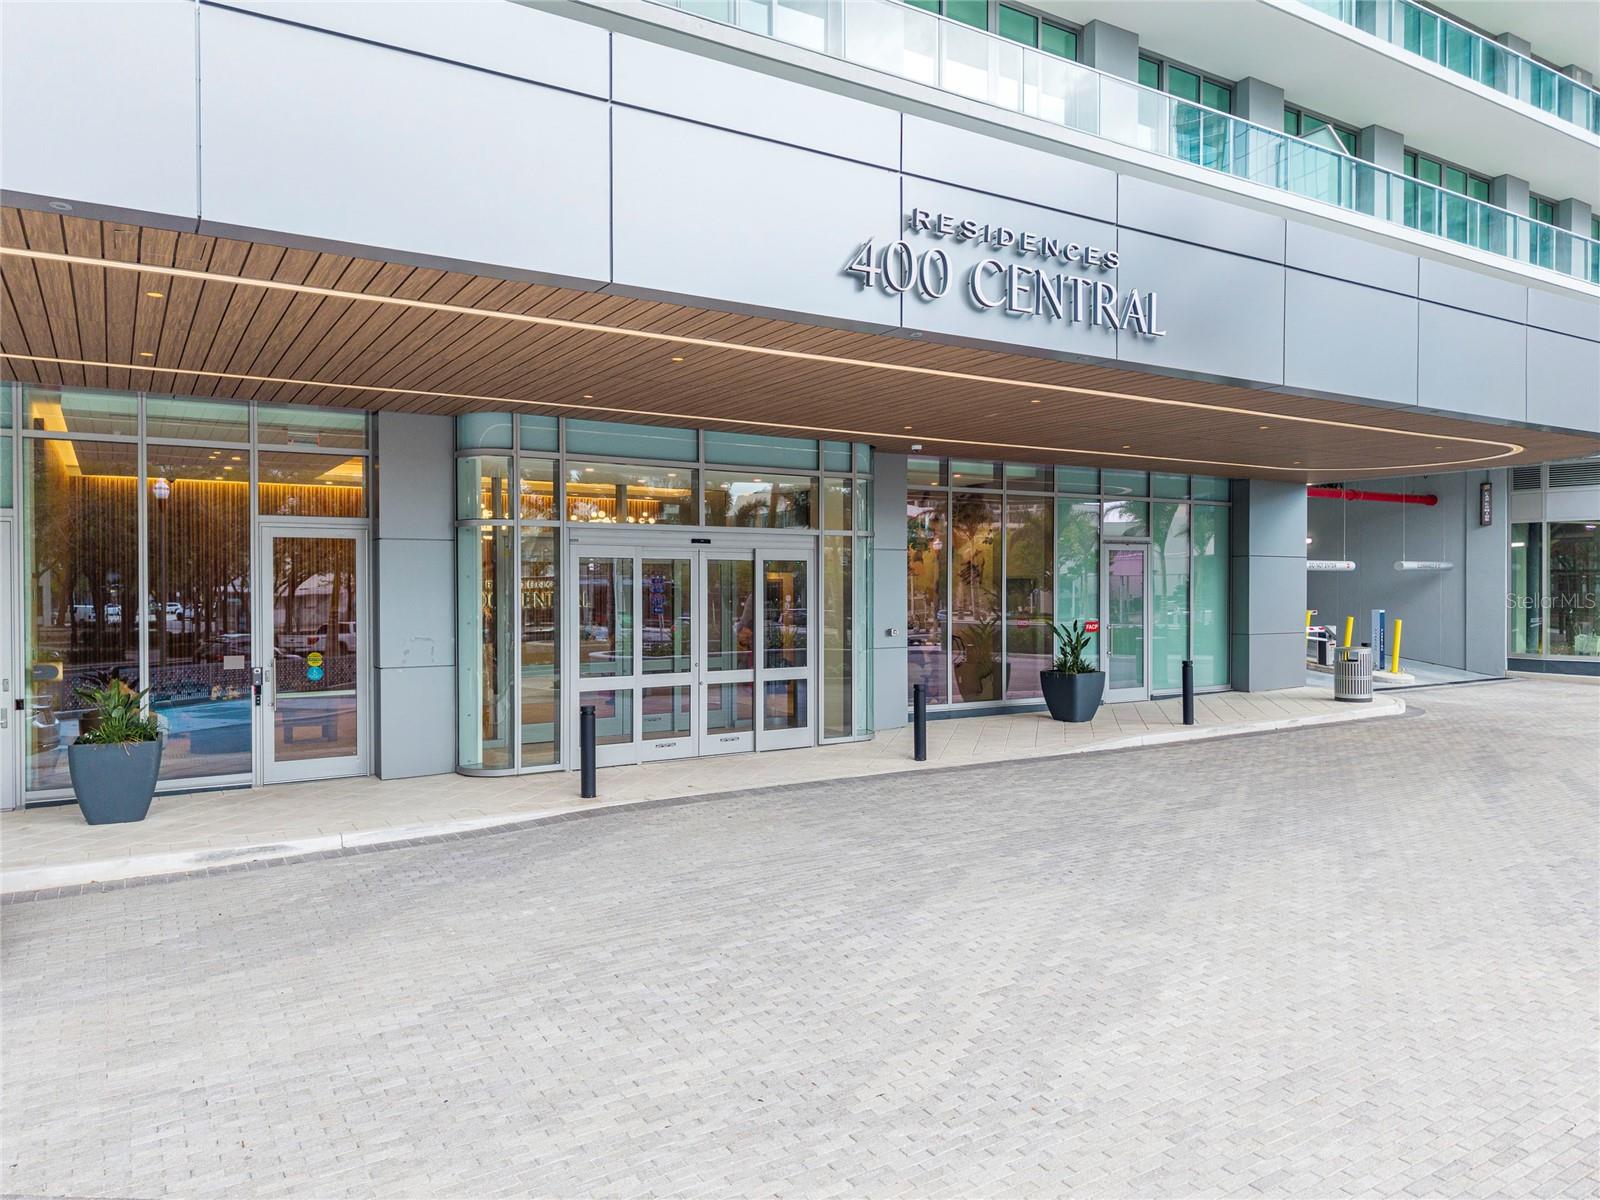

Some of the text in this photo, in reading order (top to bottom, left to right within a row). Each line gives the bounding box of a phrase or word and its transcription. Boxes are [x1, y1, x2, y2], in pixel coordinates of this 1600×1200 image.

[909, 207, 1120, 270] RESIDENCES
[846, 237, 1166, 337] 400 CENTRAL
